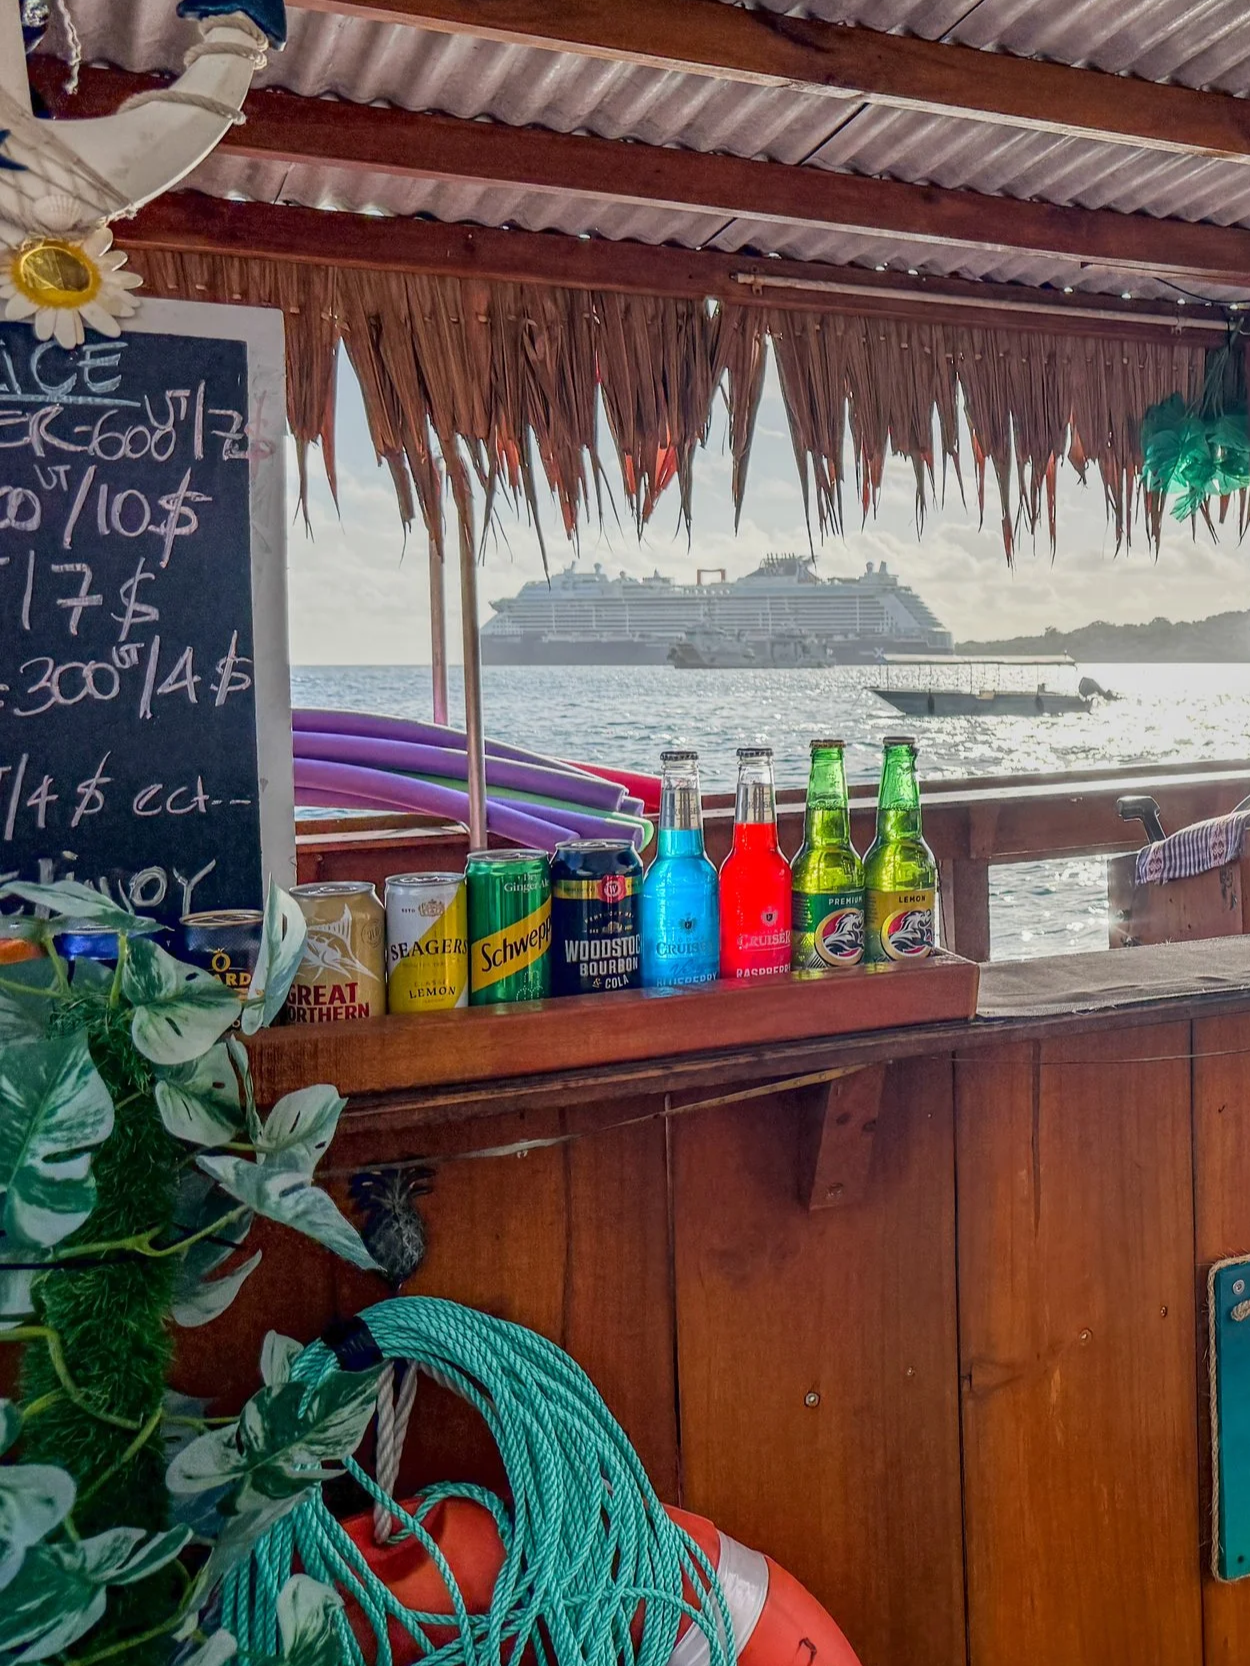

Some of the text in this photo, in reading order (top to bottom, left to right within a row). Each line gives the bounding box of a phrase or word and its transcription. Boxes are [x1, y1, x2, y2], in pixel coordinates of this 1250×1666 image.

[504, 879, 537, 893] Ginger
[898, 895, 926, 904] LEMON
[580, 957, 639, 977] BOURBON
[605, 974, 629, 989] COLA
[409, 986, 457, 999] LEMON
[286, 1002, 370, 1023] ORTHERN
